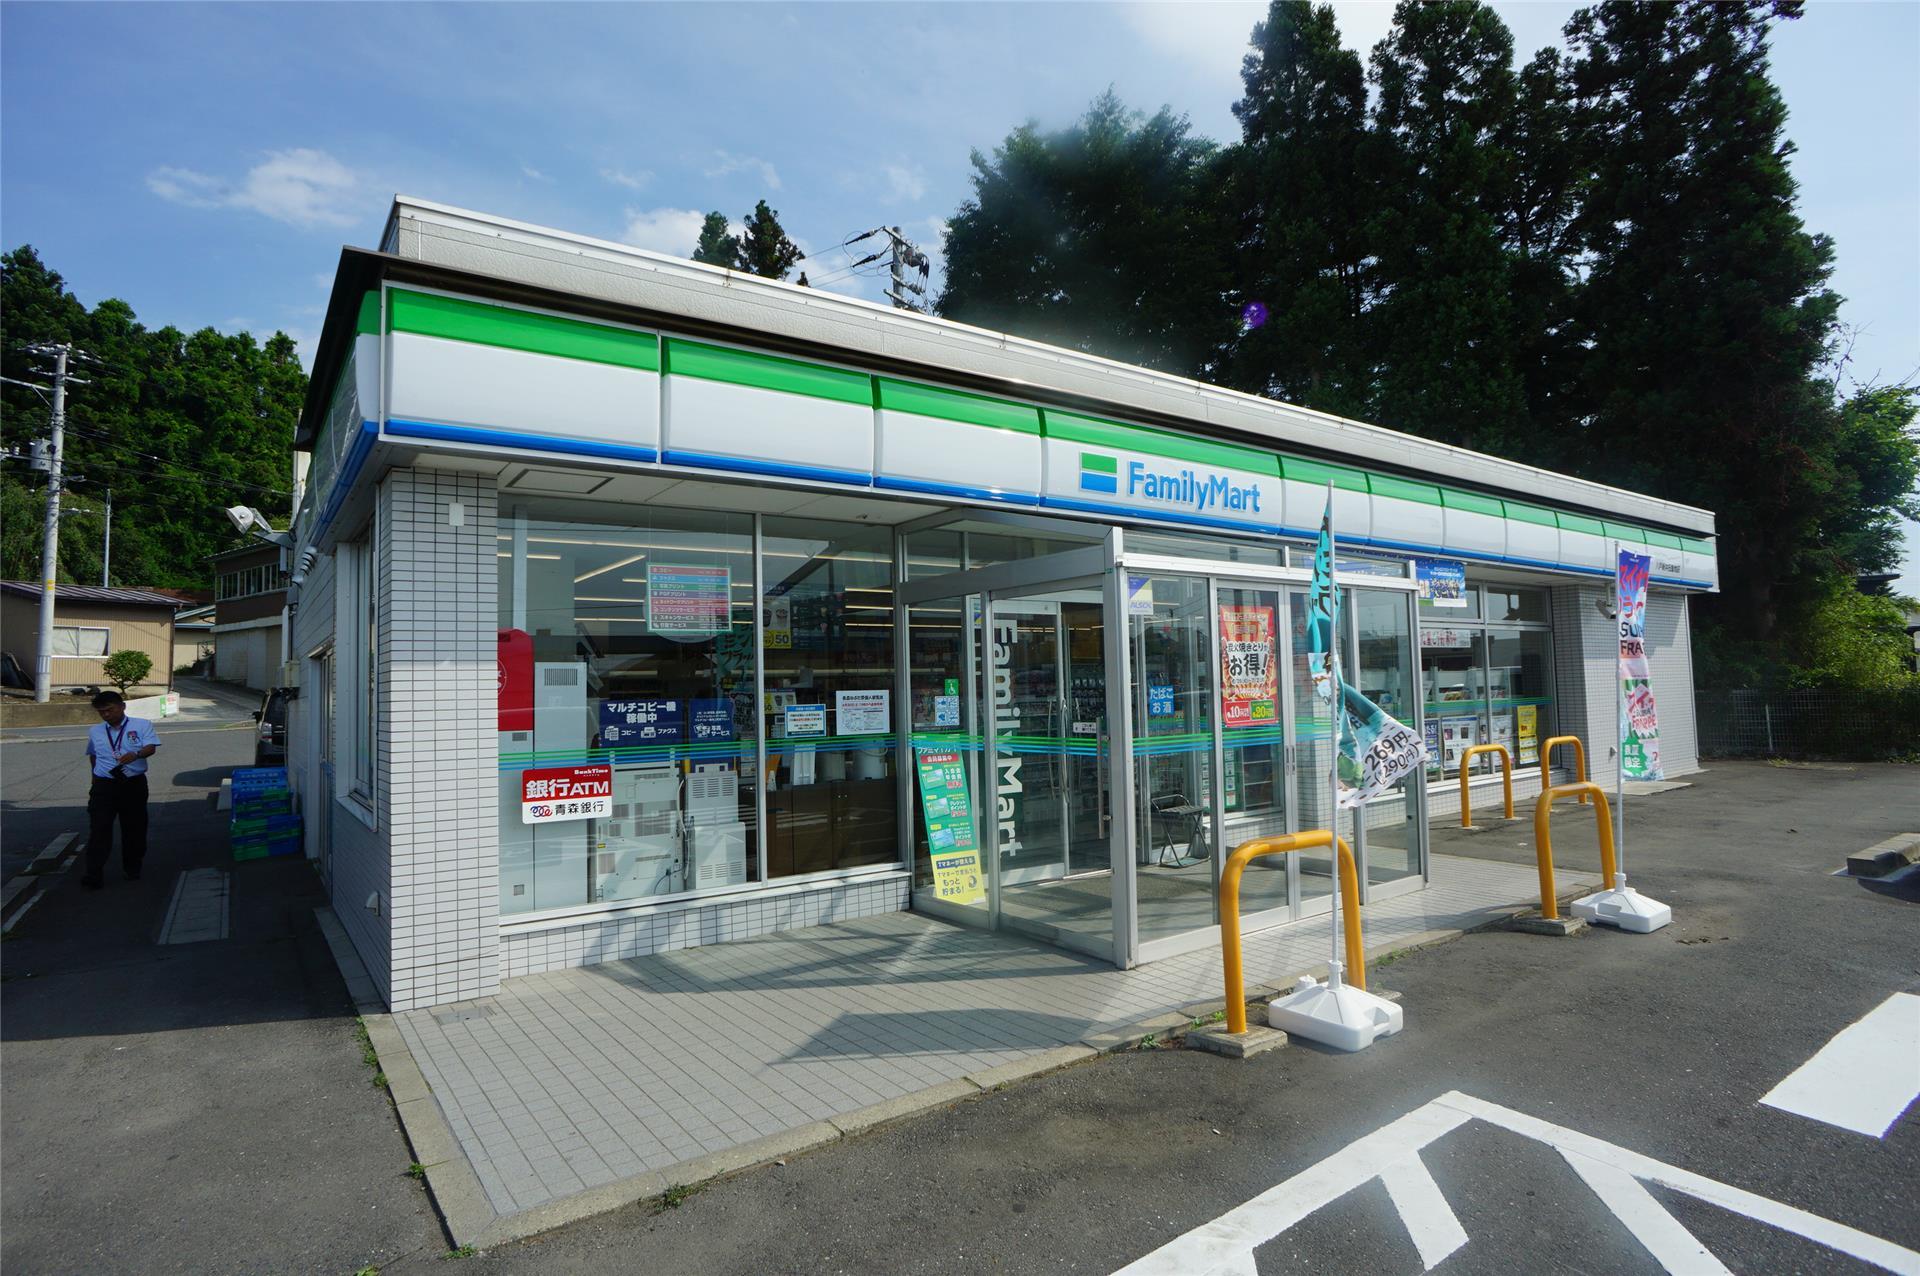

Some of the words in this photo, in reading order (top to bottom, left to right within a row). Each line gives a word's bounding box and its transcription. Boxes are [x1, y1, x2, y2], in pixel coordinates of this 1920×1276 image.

[1129, 461, 1260, 513] FamilyMart
[1620, 640, 1646, 656] FRA
[1229, 653, 1268, 677] お得!
[1150, 687, 1174, 700] たばこ
[607, 701, 677, 713] マルチコピー機
[1152, 701, 1172, 713] お酒
[626, 712, 658, 724] 稼働中
[1365, 730, 1409, 771] 269円
[526, 778, 609, 799] 銀行ATM
[555, 800, 604, 816] 青森銀行
[943, 877, 960, 887] もっと
[942, 886, 965, 897] 貯まる!
